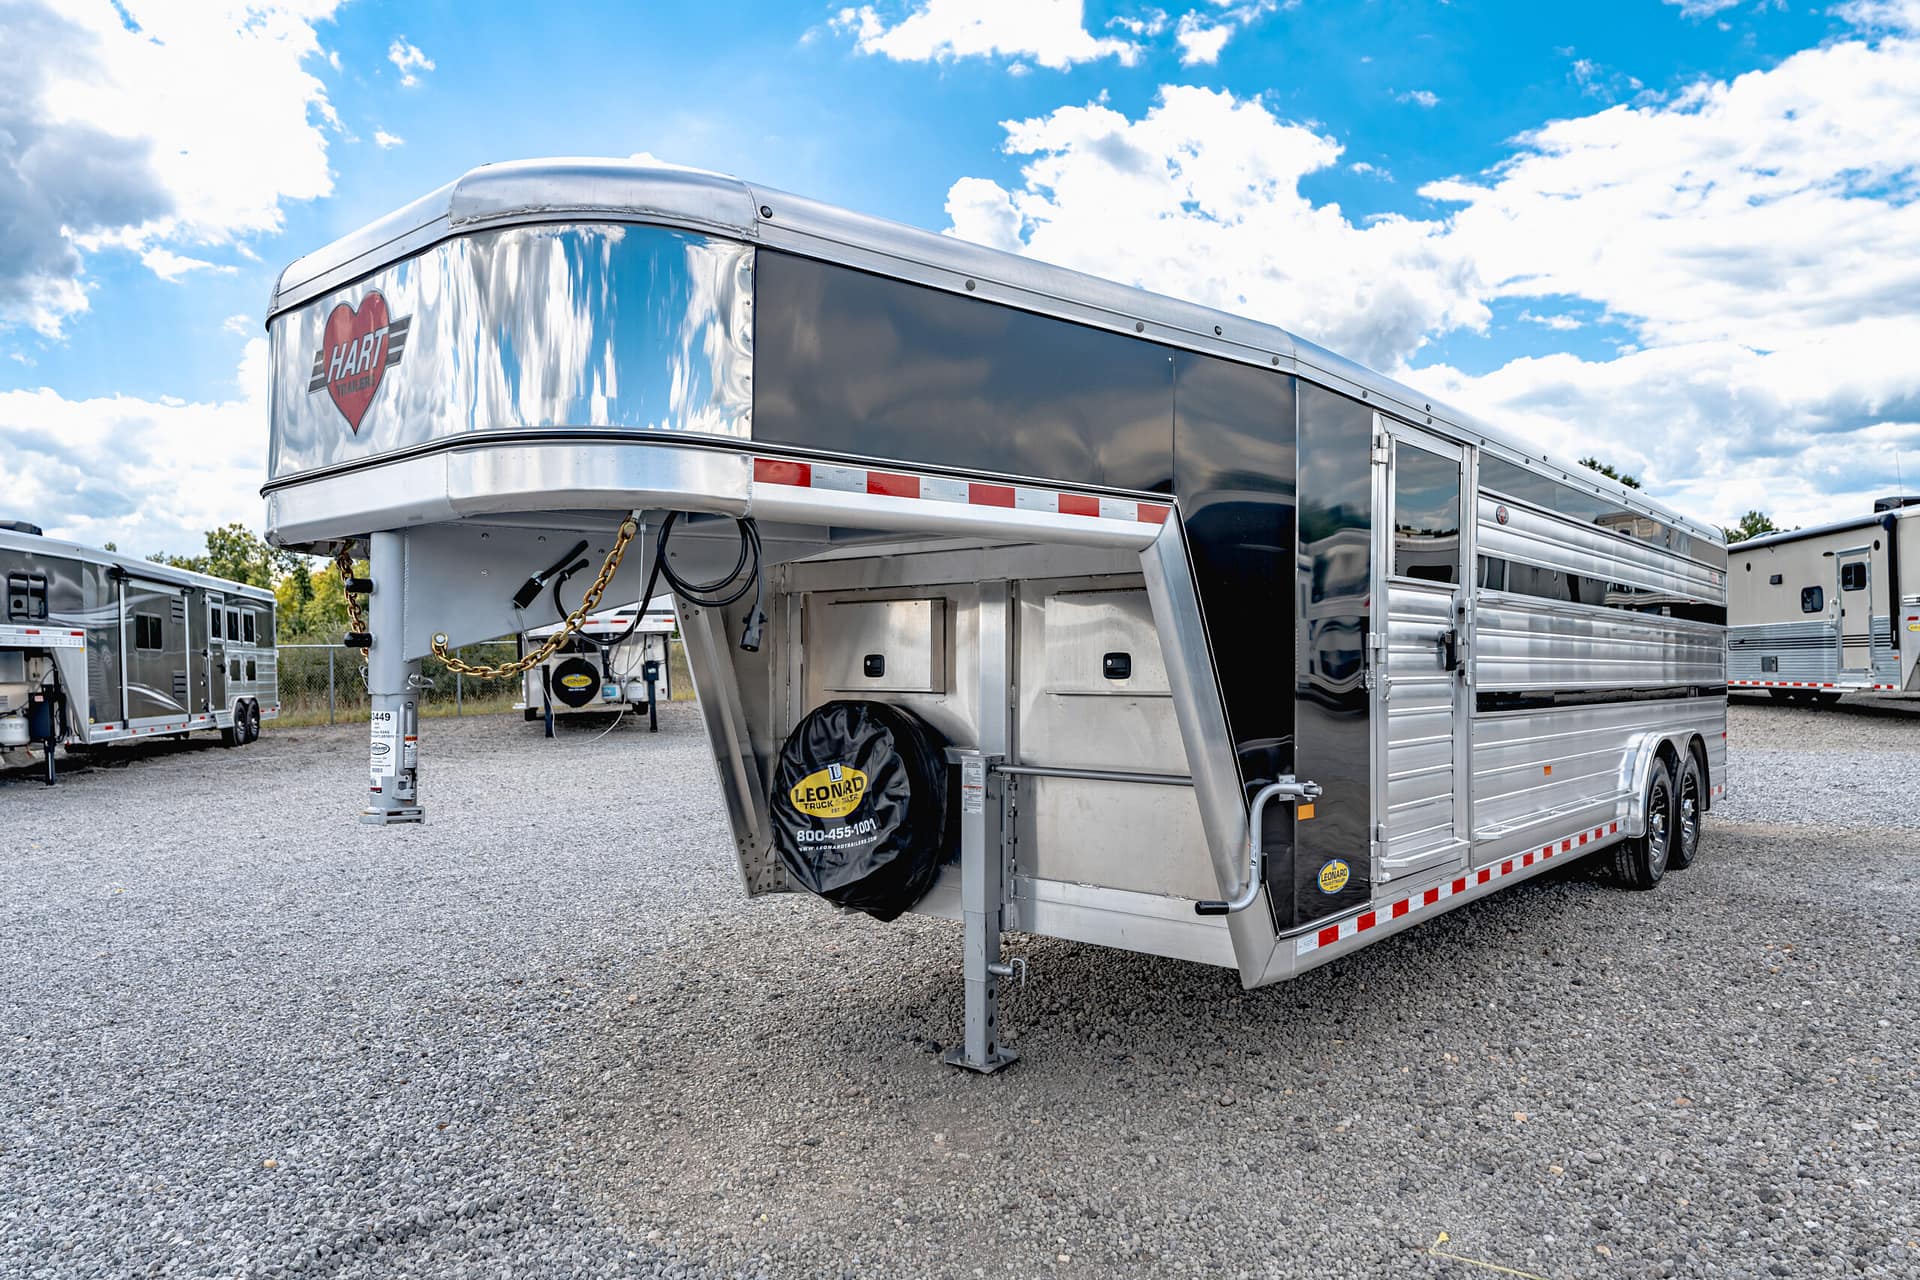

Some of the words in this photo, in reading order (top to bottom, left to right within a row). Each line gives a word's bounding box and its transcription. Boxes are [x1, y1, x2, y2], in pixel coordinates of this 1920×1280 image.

[328, 326, 389, 383] HART
[804, 800, 833, 810] TRUCK
[796, 818, 877, 842] 800-455-1001
[1321, 867, 1348, 882] LEONARD
